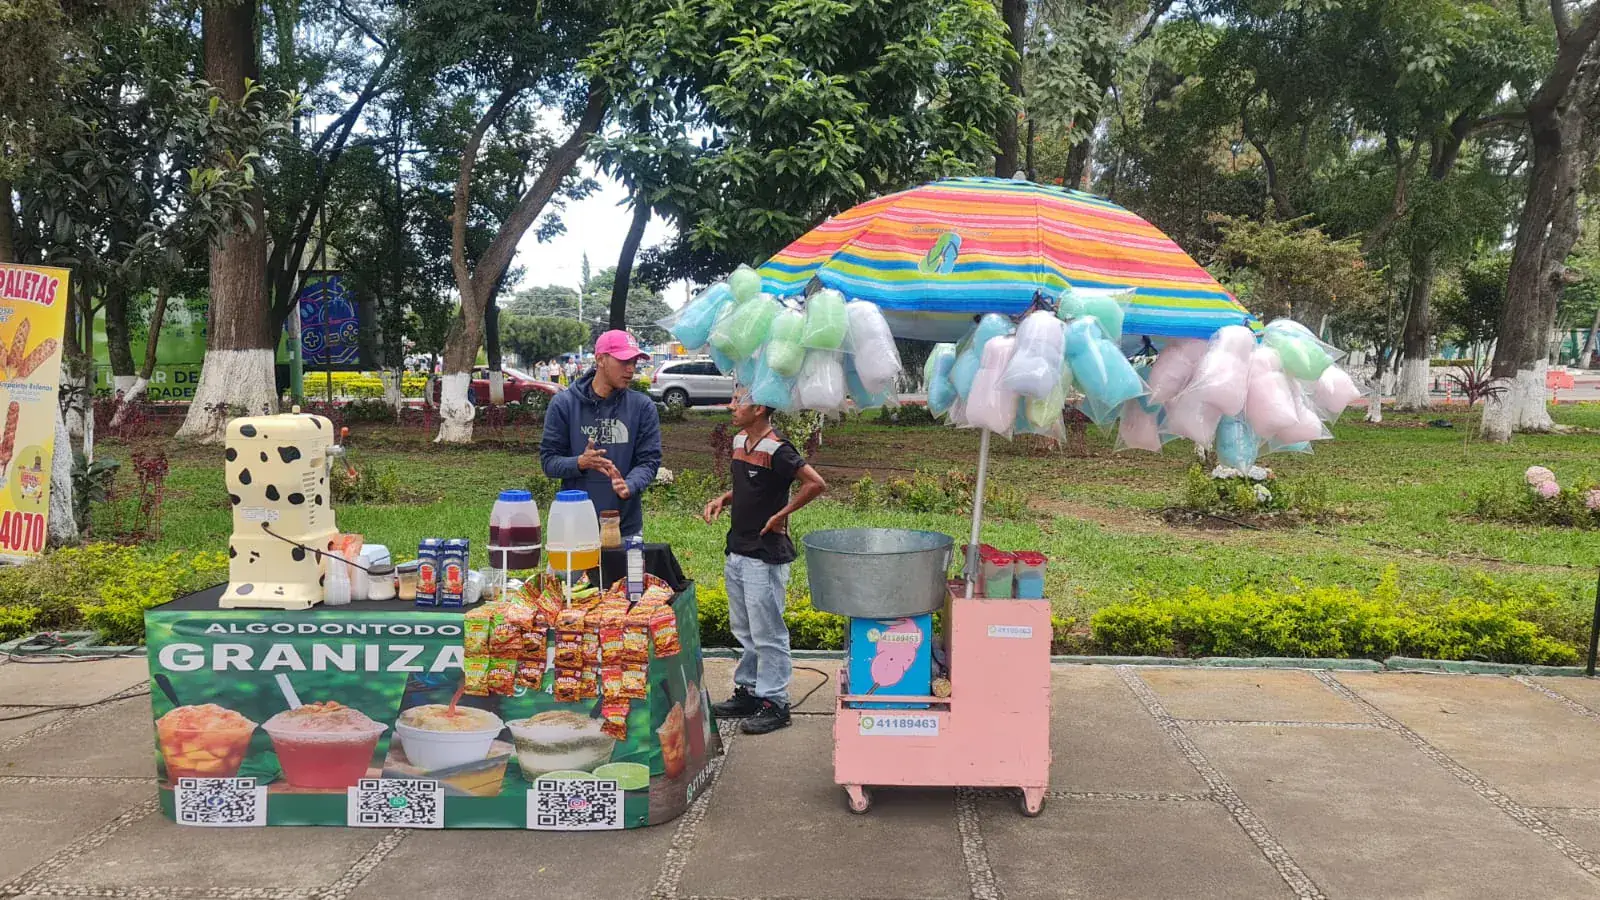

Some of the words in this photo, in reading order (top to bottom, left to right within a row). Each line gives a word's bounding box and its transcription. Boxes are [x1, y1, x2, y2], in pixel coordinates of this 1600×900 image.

[0, 511, 44, 552] 4070
[205, 623, 462, 635] ALGODONTODO
[158, 643, 464, 673] GRANIZA
[876, 719, 937, 729] 41189463
